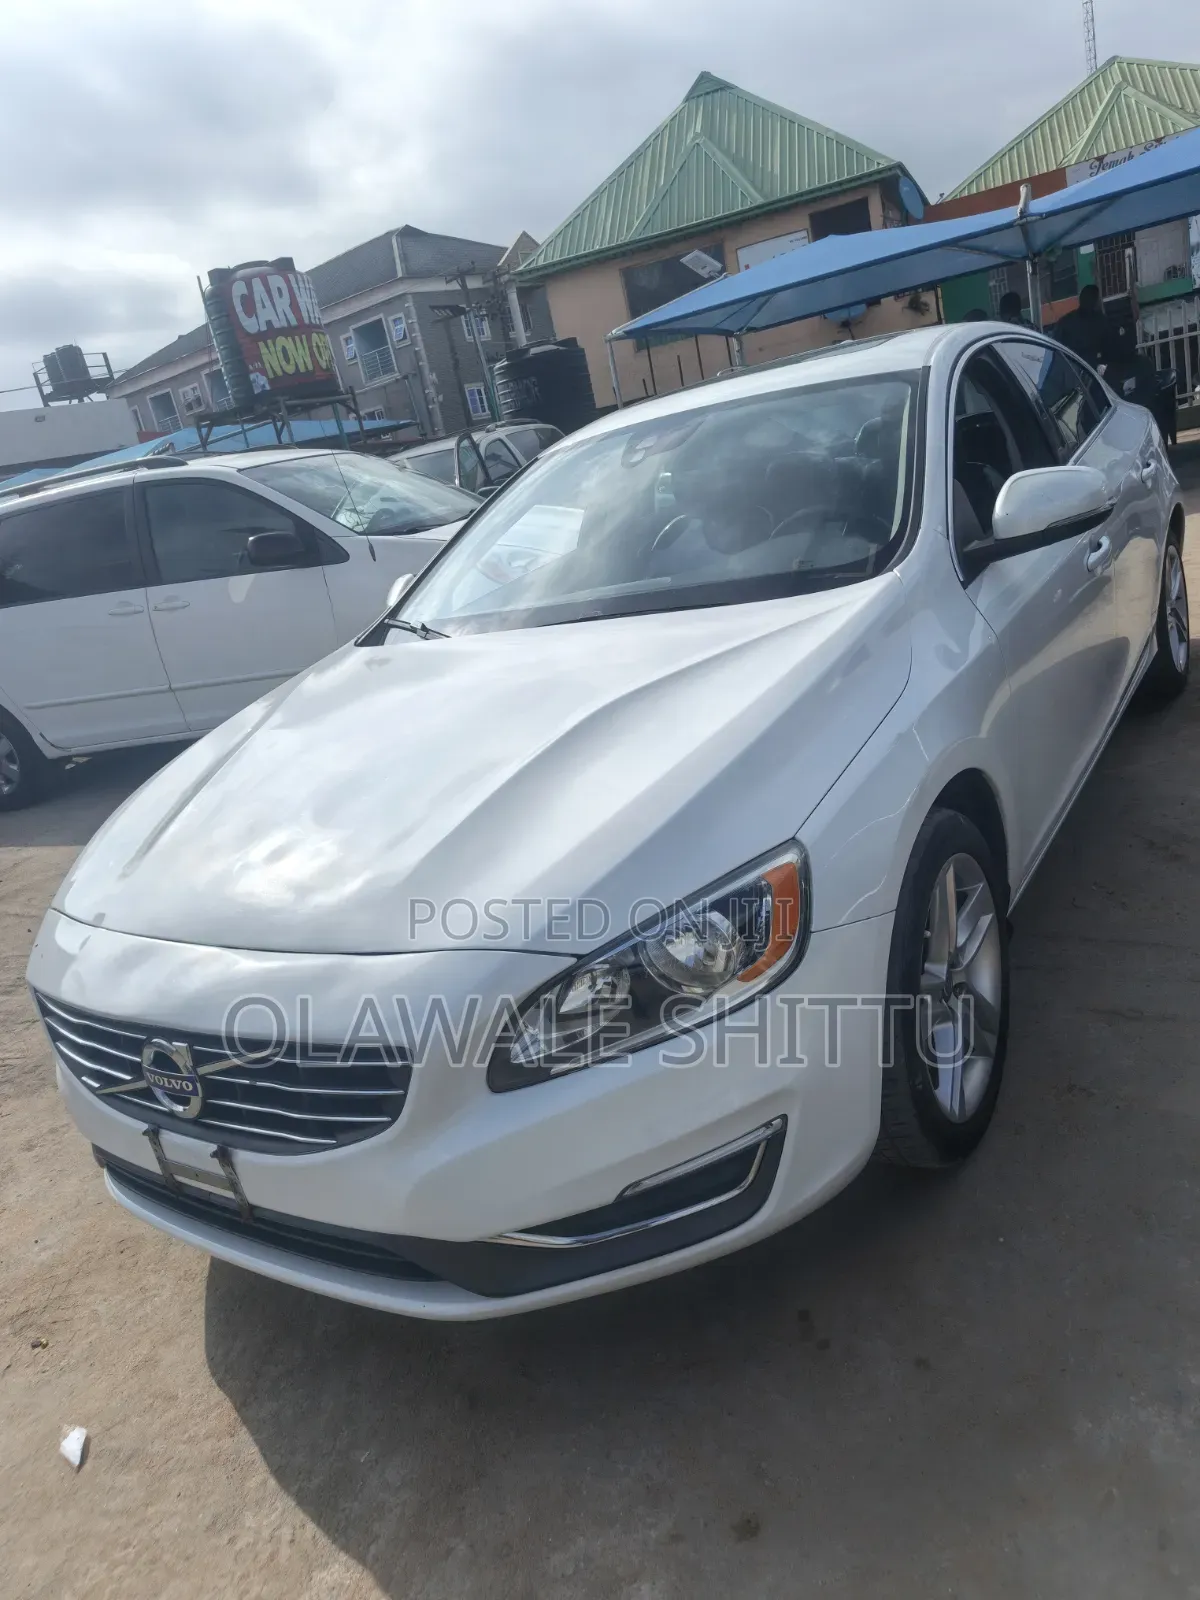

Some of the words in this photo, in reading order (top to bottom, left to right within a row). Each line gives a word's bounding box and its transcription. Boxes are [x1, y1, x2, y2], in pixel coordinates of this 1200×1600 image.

[231, 273, 298, 334] CAR
[257, 334, 314, 379] NOW
[145, 1071, 193, 1092] VOLVO
